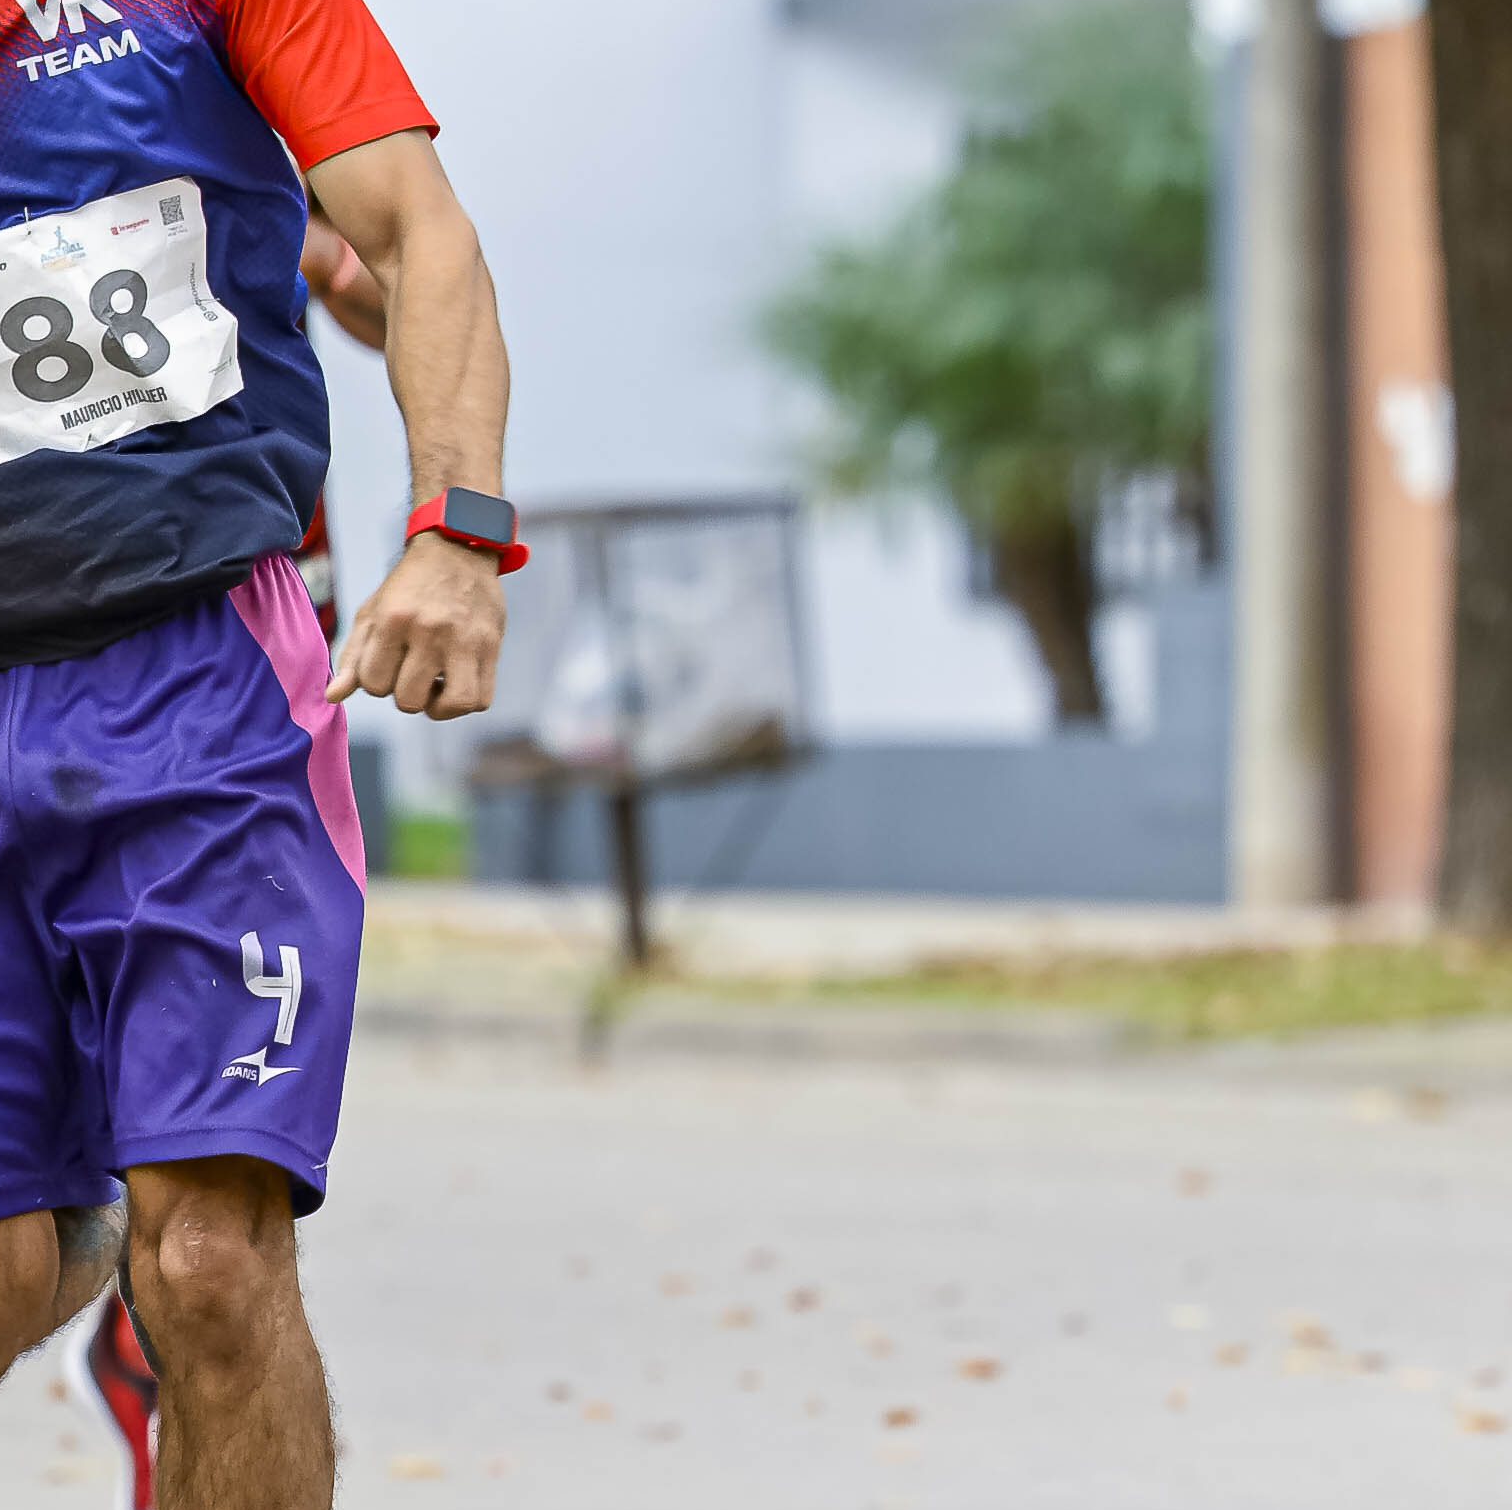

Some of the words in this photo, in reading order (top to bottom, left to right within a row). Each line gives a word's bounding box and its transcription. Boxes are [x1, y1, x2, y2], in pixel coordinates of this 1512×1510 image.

[16, 28, 142, 82] TEAM
[0, 269, 171, 403] 88
[60, 394, 123, 430] MAURICIO
[240, 931, 302, 1045] 4
